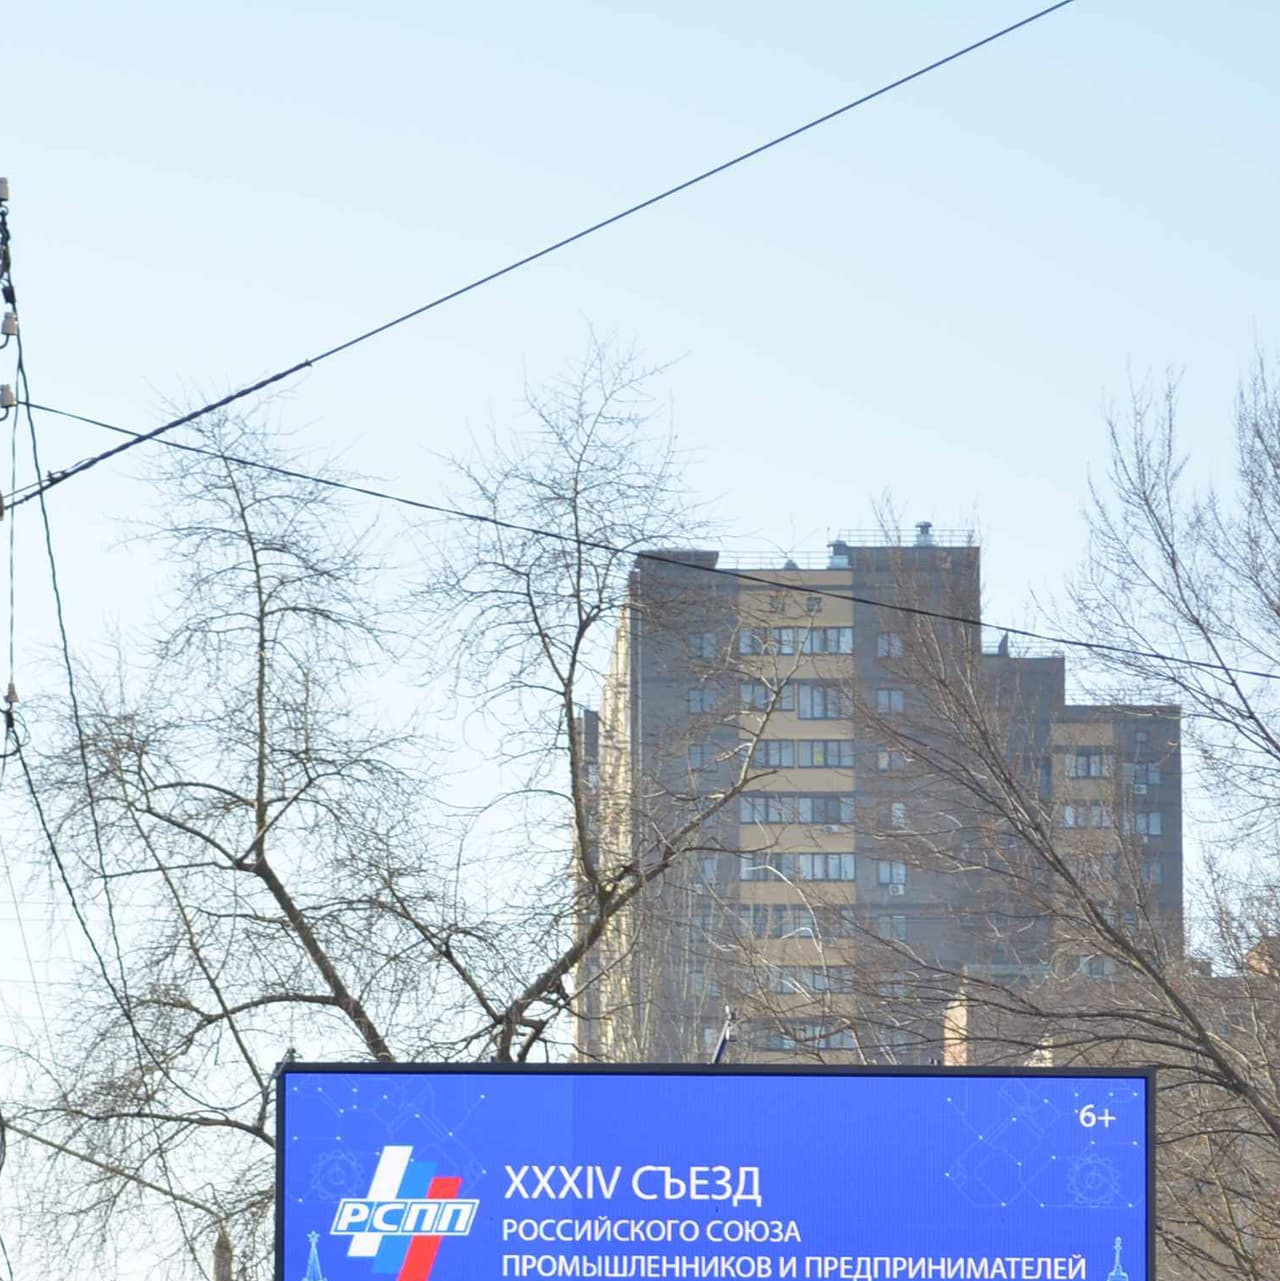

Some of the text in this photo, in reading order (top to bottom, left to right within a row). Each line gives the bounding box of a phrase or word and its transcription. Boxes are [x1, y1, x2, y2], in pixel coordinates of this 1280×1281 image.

[1079, 1104, 1117, 1128] 6+
[503, 1165, 763, 1208] XXXIV СЪЕЗД
[336, 1203, 471, 1231] РСПП
[502, 1216, 802, 1243] РОССИЙСКОГО СОЮЗА
[501, 1254, 772, 1279] ПРОМЫШЛЕННИКОВ
[778, 1256, 797, 1279] И
